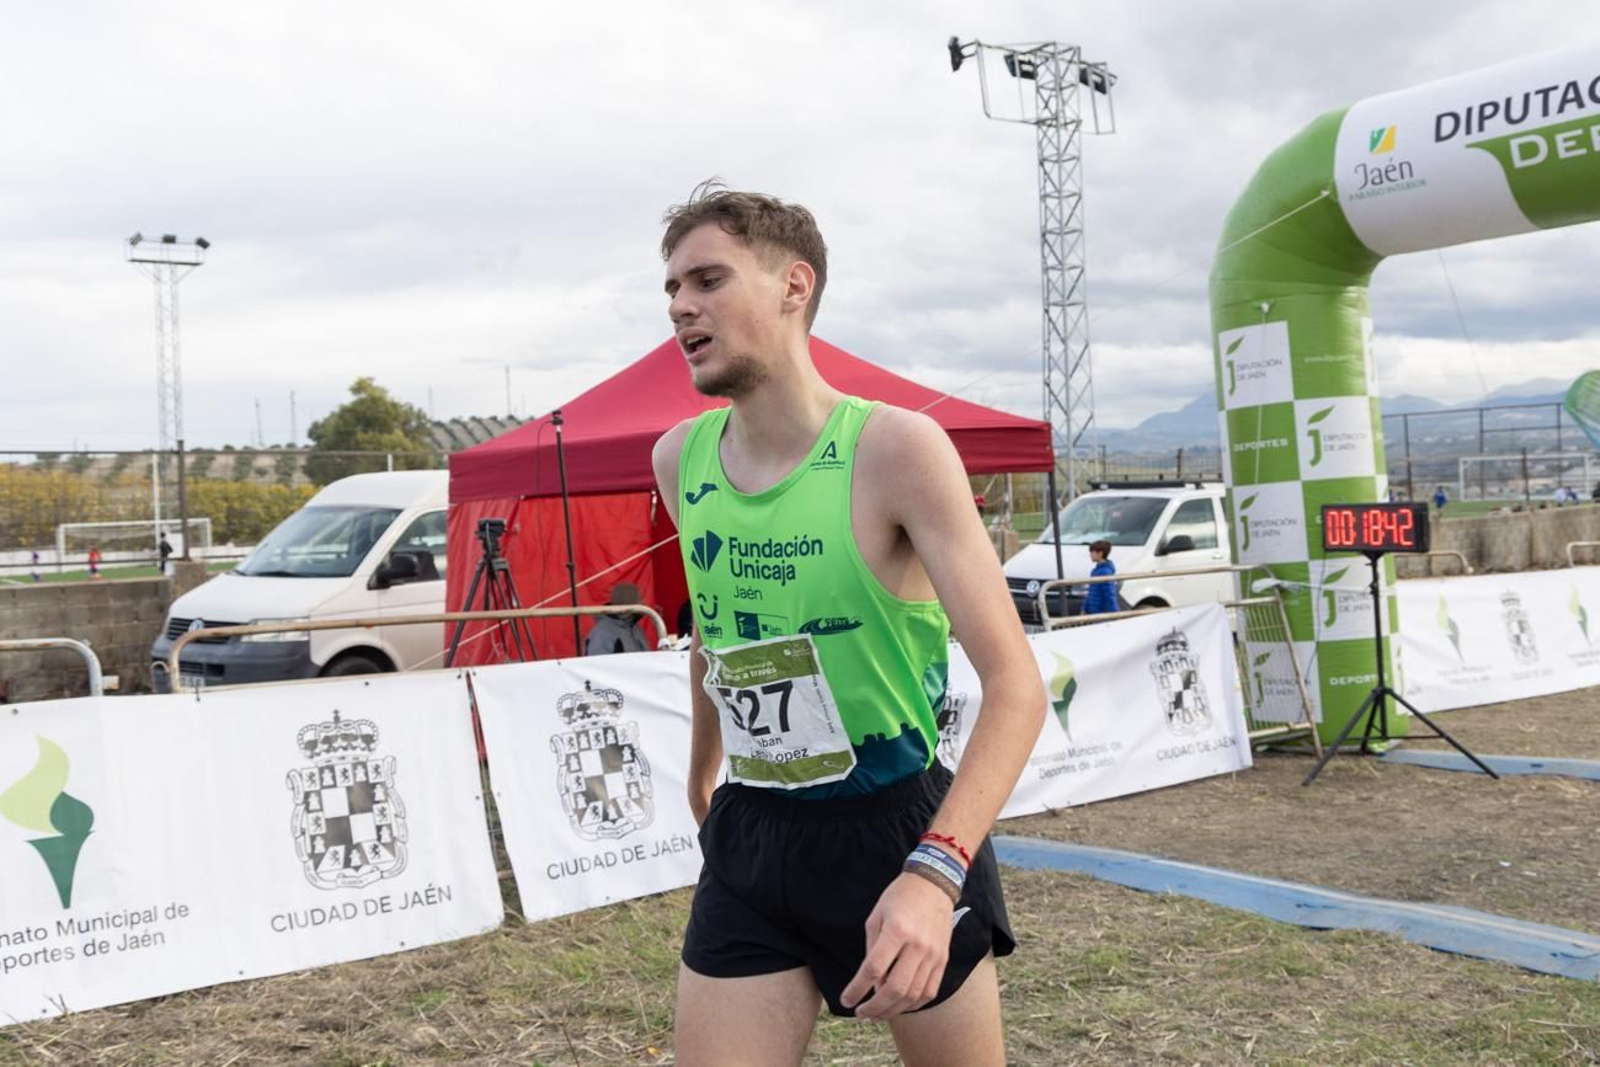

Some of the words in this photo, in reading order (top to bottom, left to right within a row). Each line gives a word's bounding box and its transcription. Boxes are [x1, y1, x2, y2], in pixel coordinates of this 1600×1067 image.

[1354, 157, 1414, 190] Jaén
[1234, 438, 1288, 452] DEPORTES
[729, 534, 823, 559] Fundación
[729, 557, 796, 587] Unicaja
[733, 585, 763, 601] Jaén
[703, 622, 723, 635] aén
[1156, 743, 1195, 761] CIUDAD
[1196, 740, 1211, 754] DE
[547, 851, 618, 880] CIUDAD
[621, 844, 646, 864] DE
[651, 833, 693, 858] JAÉN
[56, 905, 158, 938] Municipal
[164, 902, 189, 921] de
[271, 902, 358, 933] CIUDAD
[364, 895, 392, 916] DE
[398, 883, 453, 911] JAÉN
[0, 946, 76, 974] portes
[83, 938, 110, 957] de
[117, 928, 165, 952] Jaén
